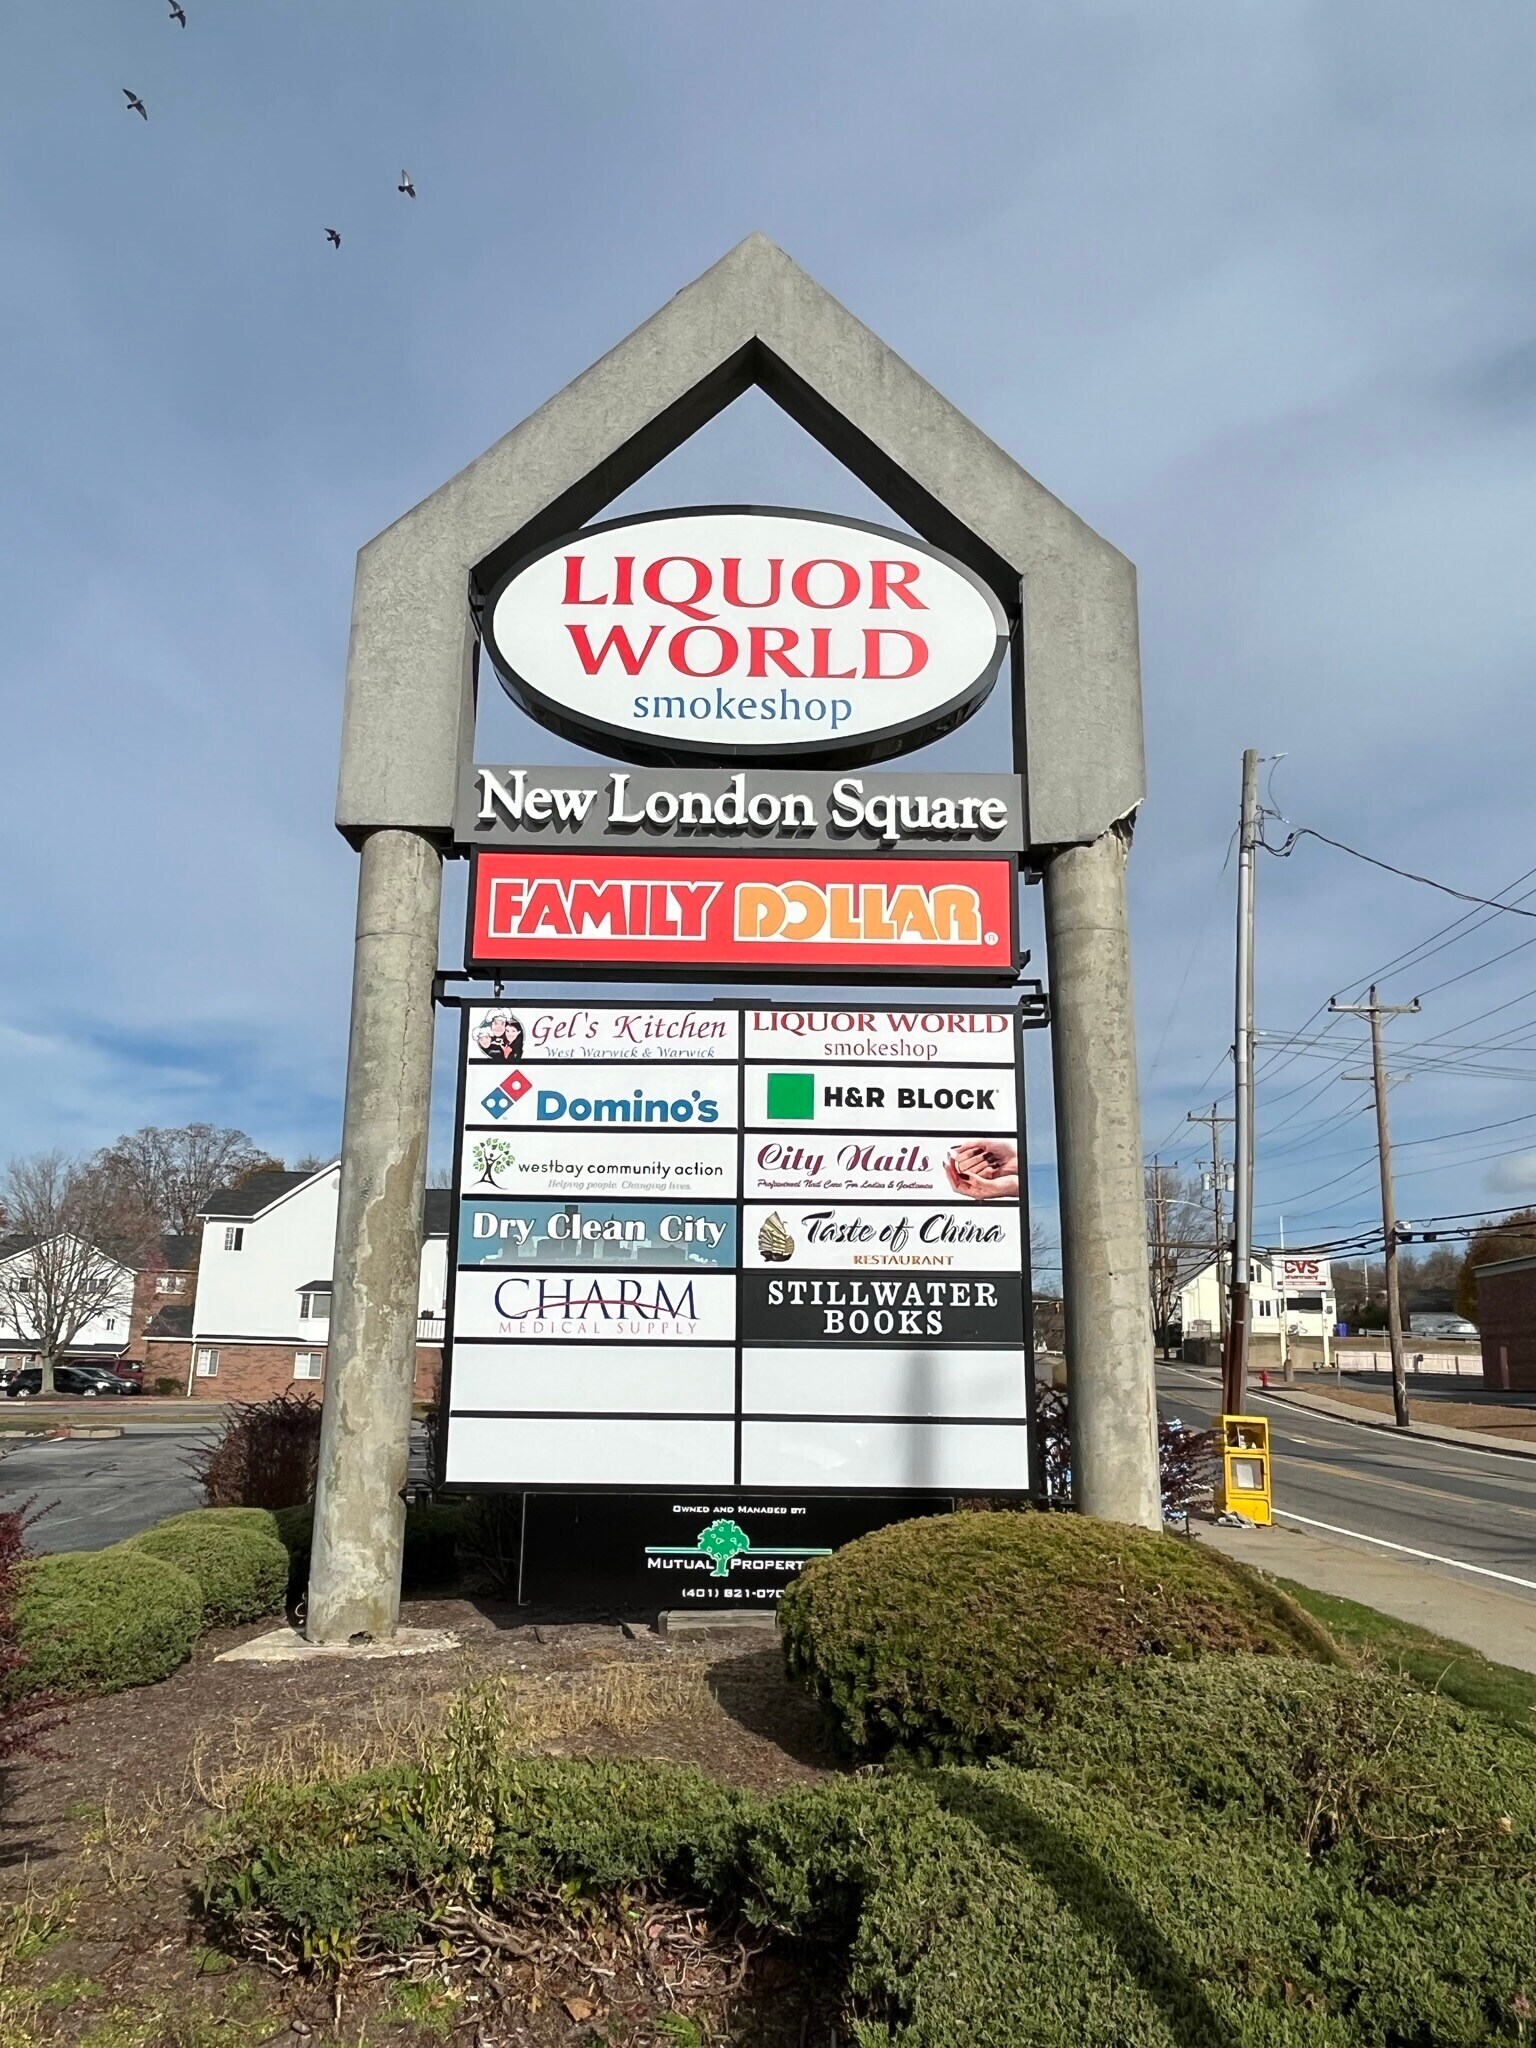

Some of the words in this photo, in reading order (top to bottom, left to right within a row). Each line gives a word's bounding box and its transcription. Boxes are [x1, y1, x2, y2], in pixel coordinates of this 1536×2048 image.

[561, 556, 930, 621] LIQUOR
[564, 624, 929, 679] WORLD
[633, 687, 852, 730] smokeshop
[477, 769, 597, 822] New
[608, 773, 818, 828] London
[832, 778, 1008, 840] Square
[487, 878, 723, 942] FAMILY
[734, 880, 983, 945] DOLLAR
[532, 1011, 599, 1046] Gel's
[612, 1012, 727, 1044] Kitchen
[753, 1011, 878, 1036] LIQUOR
[886, 1013, 1009, 1033] WORLD
[544, 1046, 575, 1058] West
[580, 1046, 638, 1058] Warwick
[642, 1047, 652, 1058] &
[657, 1046, 715, 1058] Warwick
[824, 1038, 938, 1060] smokeshop
[536, 1089, 719, 1123] Domino's
[824, 1086, 885, 1108] H&R
[897, 1088, 996, 1110] BLOCK
[518, 1159, 584, 1178] westbay
[587, 1161, 671, 1179] community
[674, 1161, 723, 1176] action
[757, 1143, 826, 1176] City
[837, 1144, 933, 1172] Nails
[472, 1211, 537, 1245] Dry
[547, 1212, 646, 1241] Clean
[659, 1214, 728, 1248] City
[801, 1210, 876, 1244] Taste
[878, 1216, 914, 1253] of
[919, 1213, 1005, 1244] China
[853, 1255, 955, 1266] RESTAURANT
[1284, 1260, 1319, 1274] CVS
[494, 1278, 700, 1320] CHARM
[768, 1280, 998, 1307] STILLWATER
[498, 1321, 600, 1334] MEDICAL
[616, 1321, 697, 1335] SUPPLY
[823, 1309, 943, 1335] BOOKS
[647, 1557, 715, 1570] MUTUAL
[730, 1558, 805, 1570] PROPERT
[682, 1588, 719, 1598] (401)
